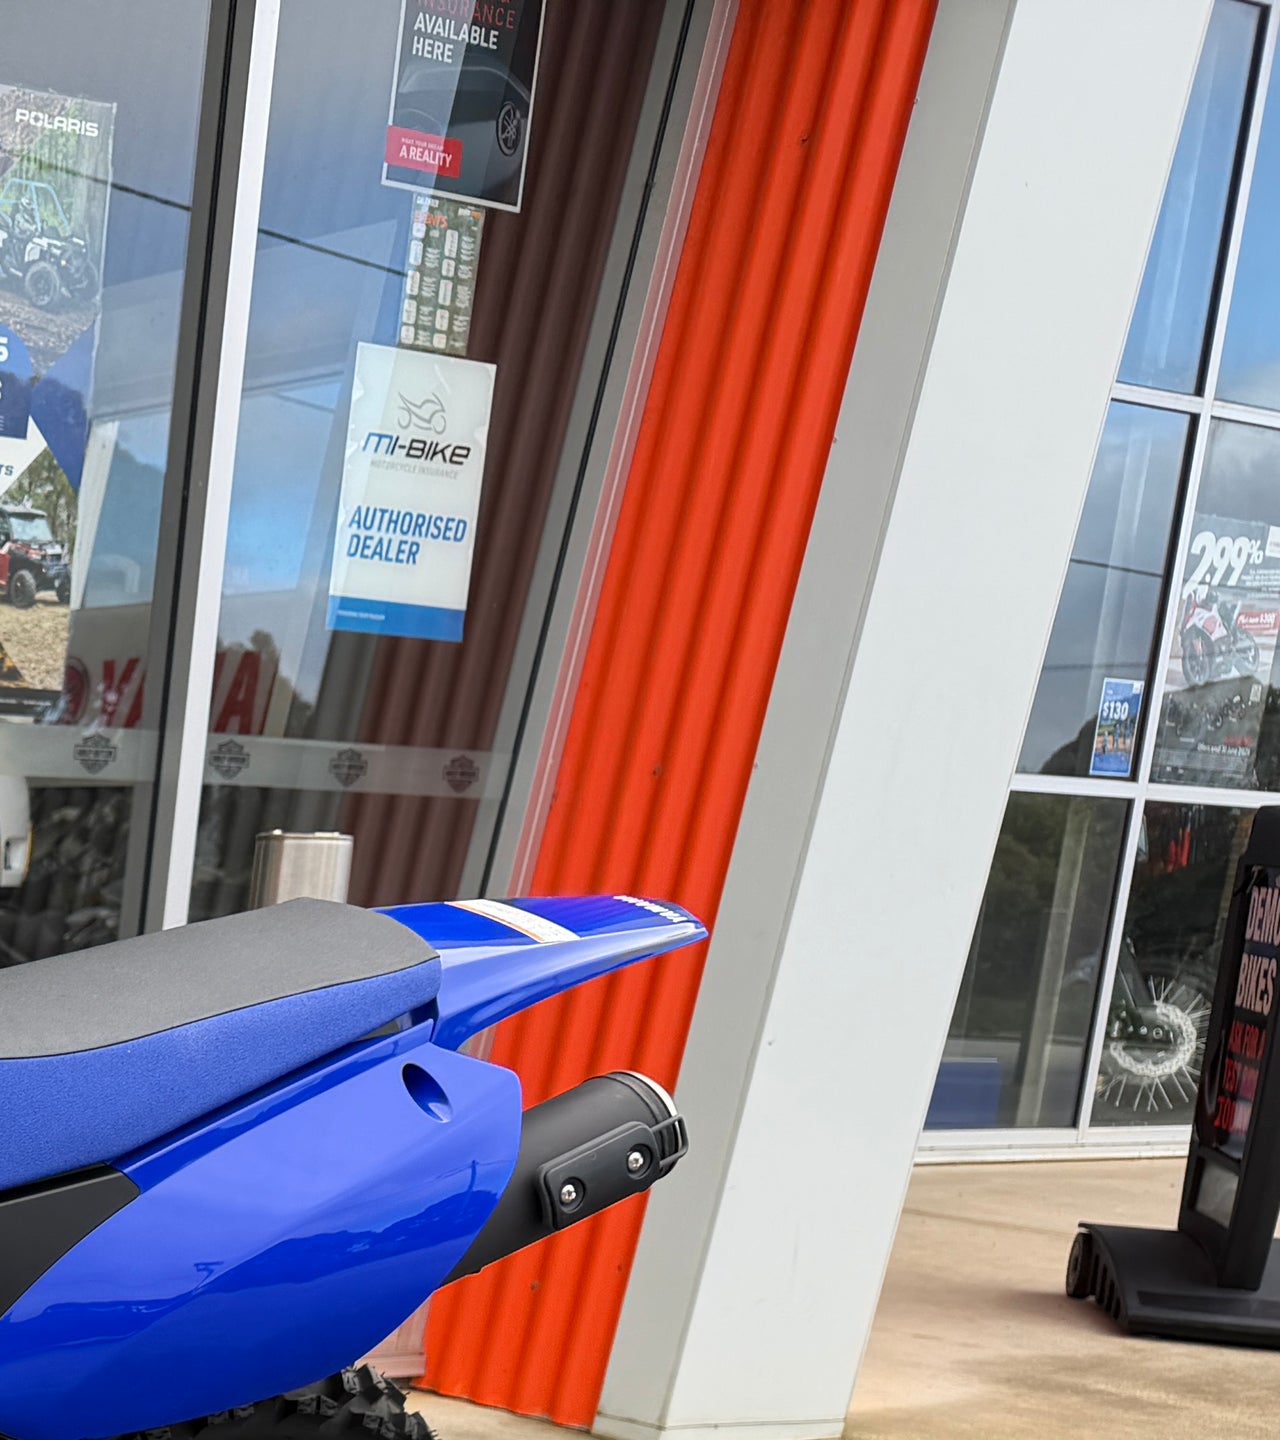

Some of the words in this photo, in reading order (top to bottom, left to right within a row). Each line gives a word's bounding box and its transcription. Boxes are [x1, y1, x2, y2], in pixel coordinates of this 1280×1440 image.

[414, 12, 499, 50] AVAILABLE
[412, 36, 454, 64] HERE
[15, 108, 99, 137] POLARIS
[399, 145, 408, 158] A
[409, 147, 452, 168] REALITY
[419, 466, 459, 480] INSURANCE
[348, 505, 468, 543] AUTHORISED
[347, 533, 420, 566] DEALER
[1102, 701, 1129, 720] $130
[1235, 952, 1277, 1017] BIKES
